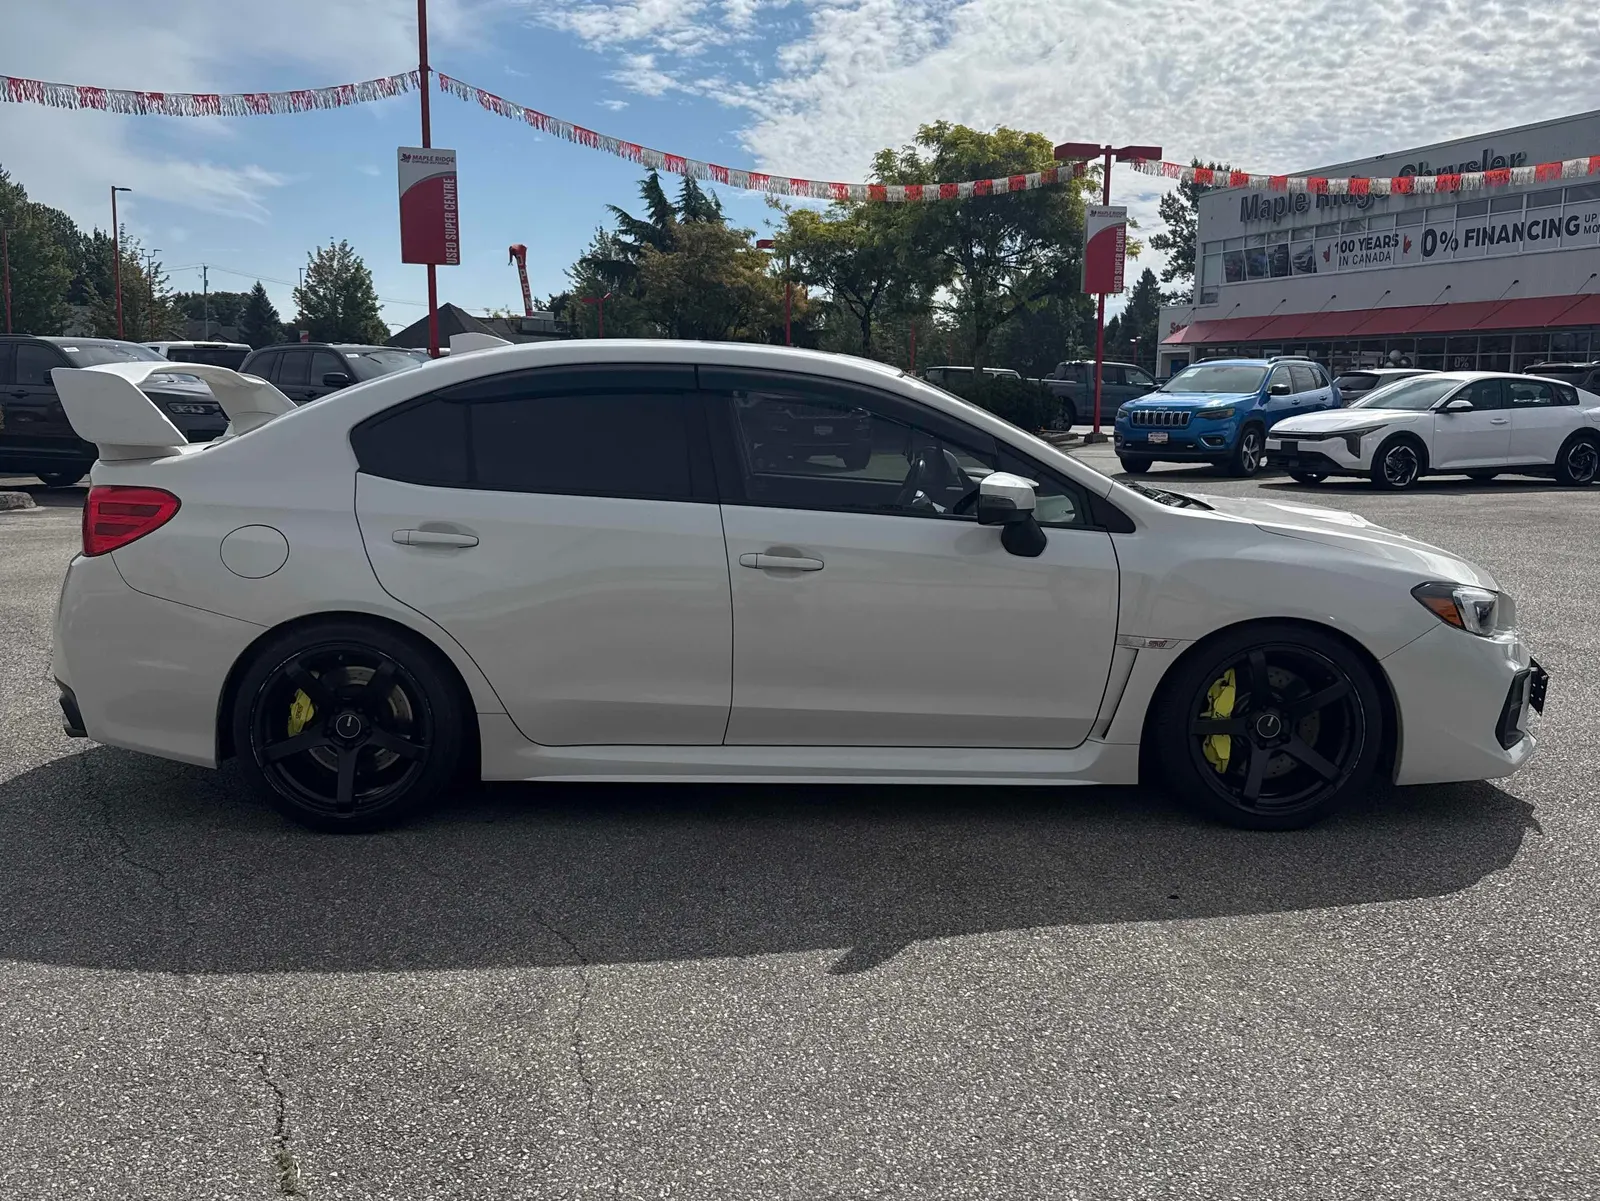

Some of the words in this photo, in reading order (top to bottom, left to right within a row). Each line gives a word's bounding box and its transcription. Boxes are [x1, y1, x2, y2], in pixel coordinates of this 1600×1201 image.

[443, 178, 455, 210] CENTRE
[1240, 192, 1310, 222] Maple
[1316, 187, 1390, 209] Rig
[445, 212, 457, 240] SUPER
[1585, 213, 1598, 223] UP
[1116, 227, 1125, 252] CENTRE
[1334, 240, 1355, 254] 100
[1359, 233, 1399, 251] YEARS
[1421, 229, 1459, 257] 0%
[1464, 215, 1580, 248] FINANCING
[446, 242, 457, 264] USED
[1115, 253, 1123, 275] SUPER
[1338, 256, 1348, 266] IN
[1352, 251, 1391, 265] CANADA
[517, 255, 532, 310] OPEN
[1114, 275, 1122, 292] USED
[1454, 356, 1469, 367] 0%
